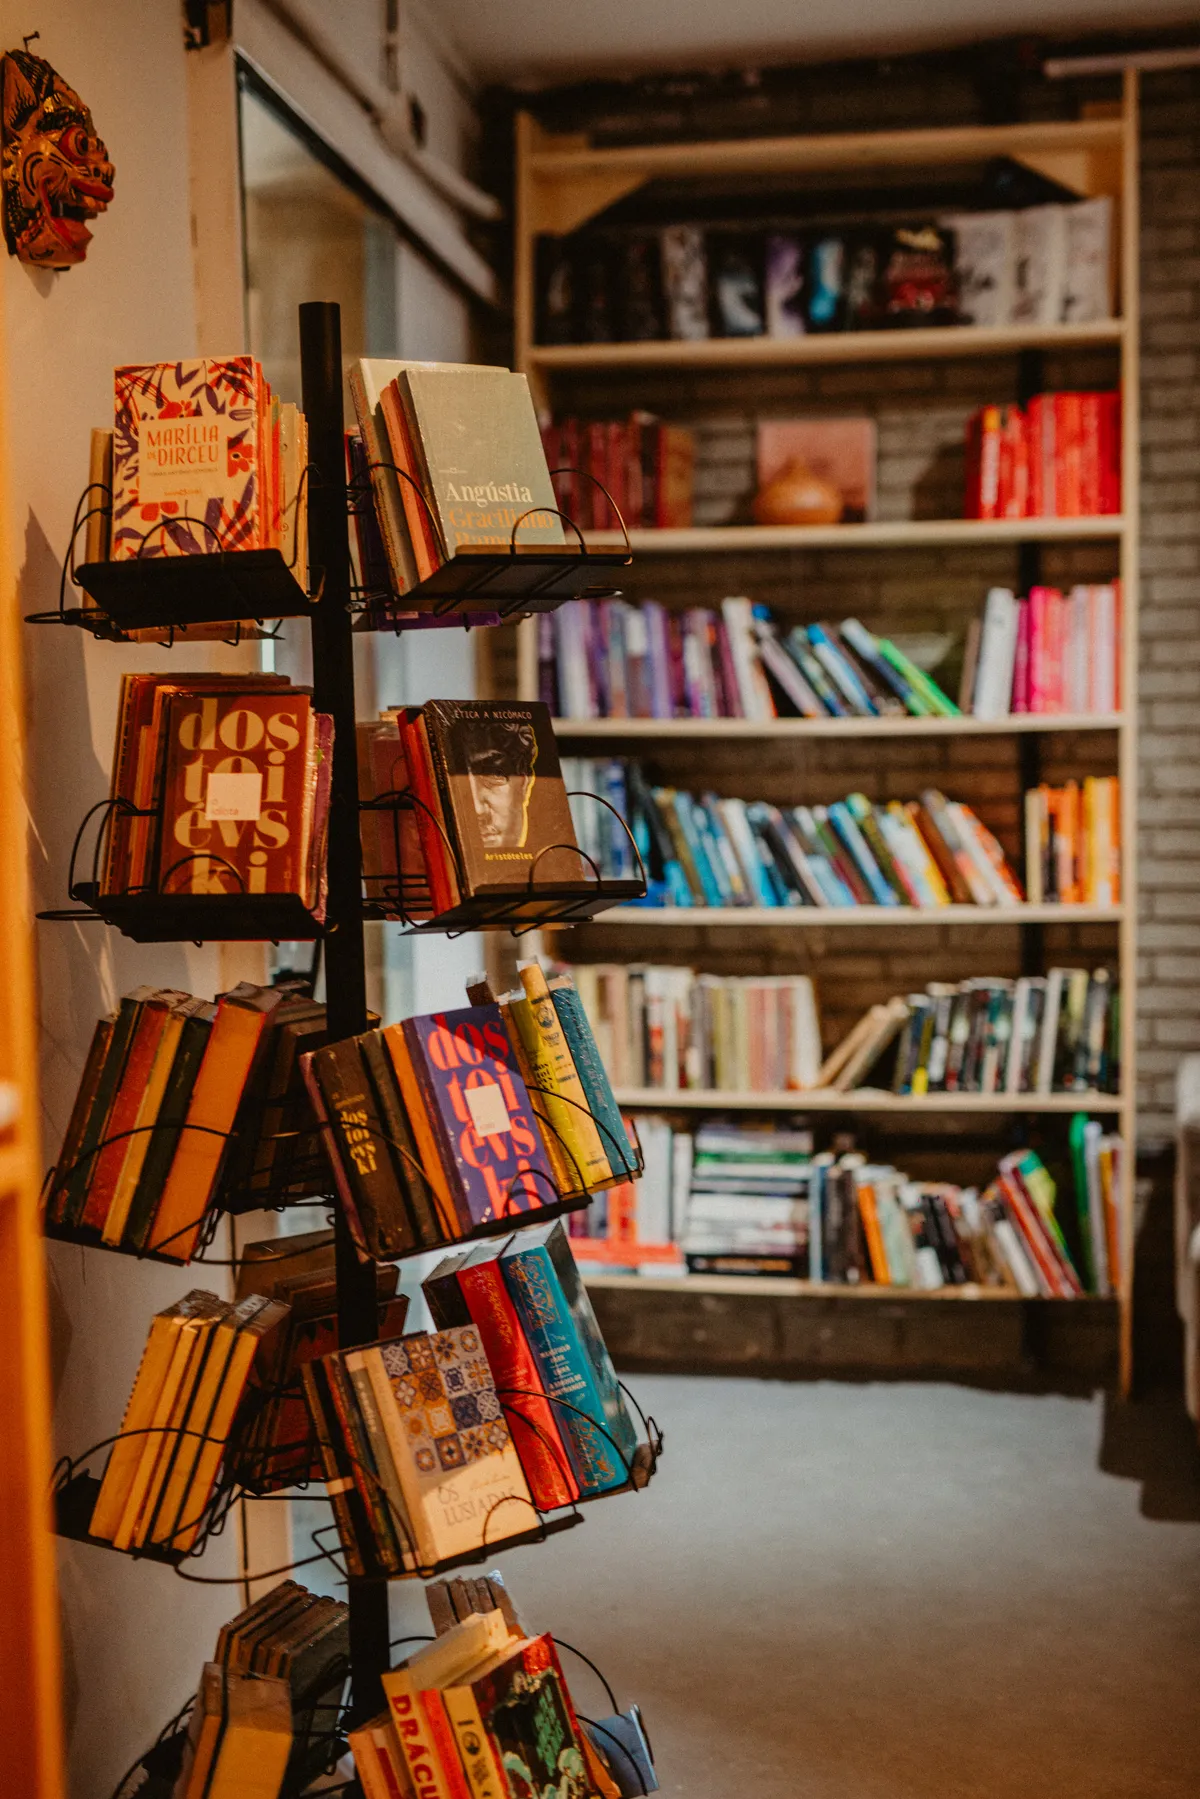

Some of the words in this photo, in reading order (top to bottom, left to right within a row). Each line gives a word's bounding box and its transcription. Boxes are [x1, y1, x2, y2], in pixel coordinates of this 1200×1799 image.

[147, 424, 218, 447] MARÍLIA
[158, 445, 219, 467] DIRCEU
[446, 481, 533, 508] Angústia
[178, 698, 300, 751] dos
[427, 1013, 509, 1071] dos
